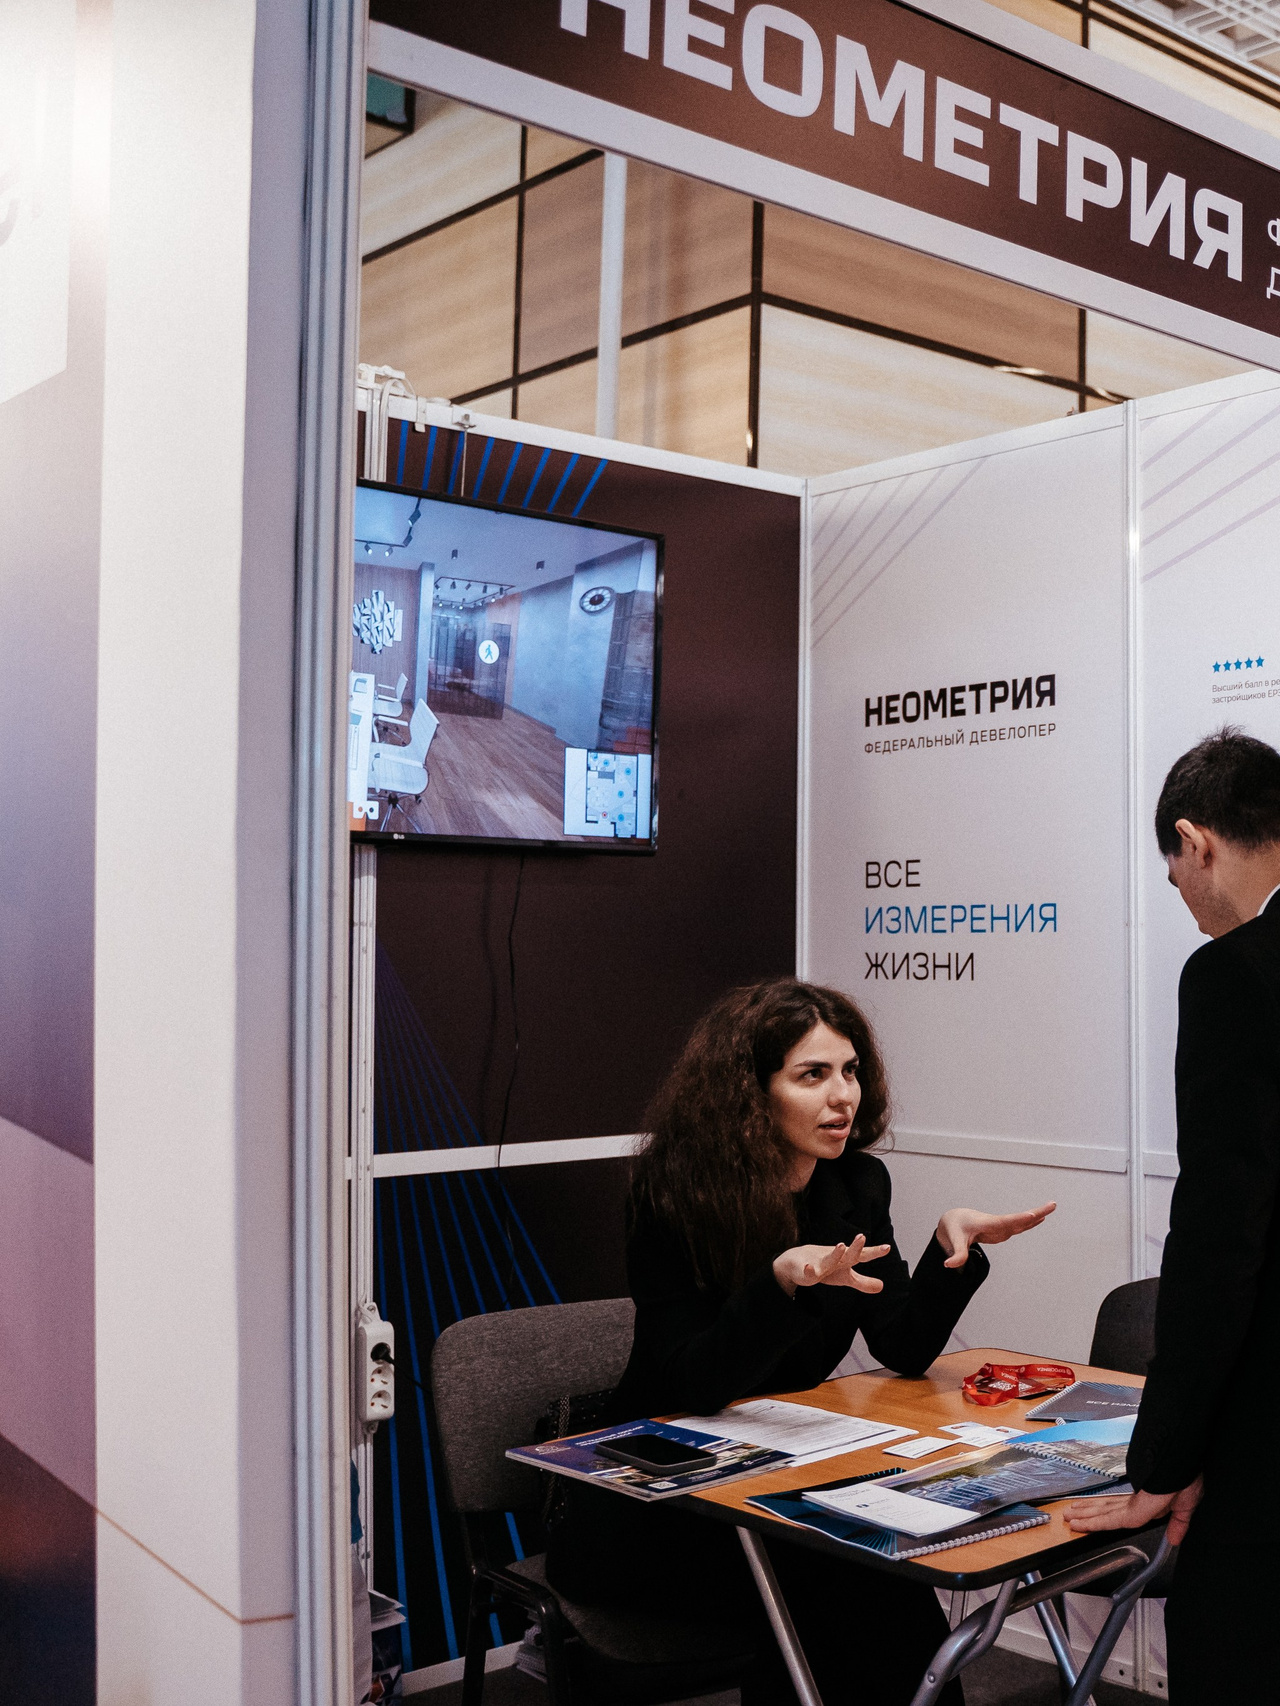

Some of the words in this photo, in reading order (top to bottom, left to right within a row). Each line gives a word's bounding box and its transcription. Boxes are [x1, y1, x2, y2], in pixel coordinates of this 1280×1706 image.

[865, 674, 1056, 727] НЕОМЕТРИЯ
[1212, 682, 1243, 693] Высший
[1244, 680, 1263, 689] балл
[1264, 679, 1270, 687] в
[1212, 692, 1266, 703] застройщиков
[864, 729, 965, 755] ФЕДЕРАЛЬНЫЙ
[969, 723, 1056, 746] ДЕВЕЛОПЕР
[865, 859, 921, 889] ВСЕ
[865, 902, 1057, 934] ИЗМЕРЕНИЯ
[865, 952, 975, 981] ЖИЗНИ
